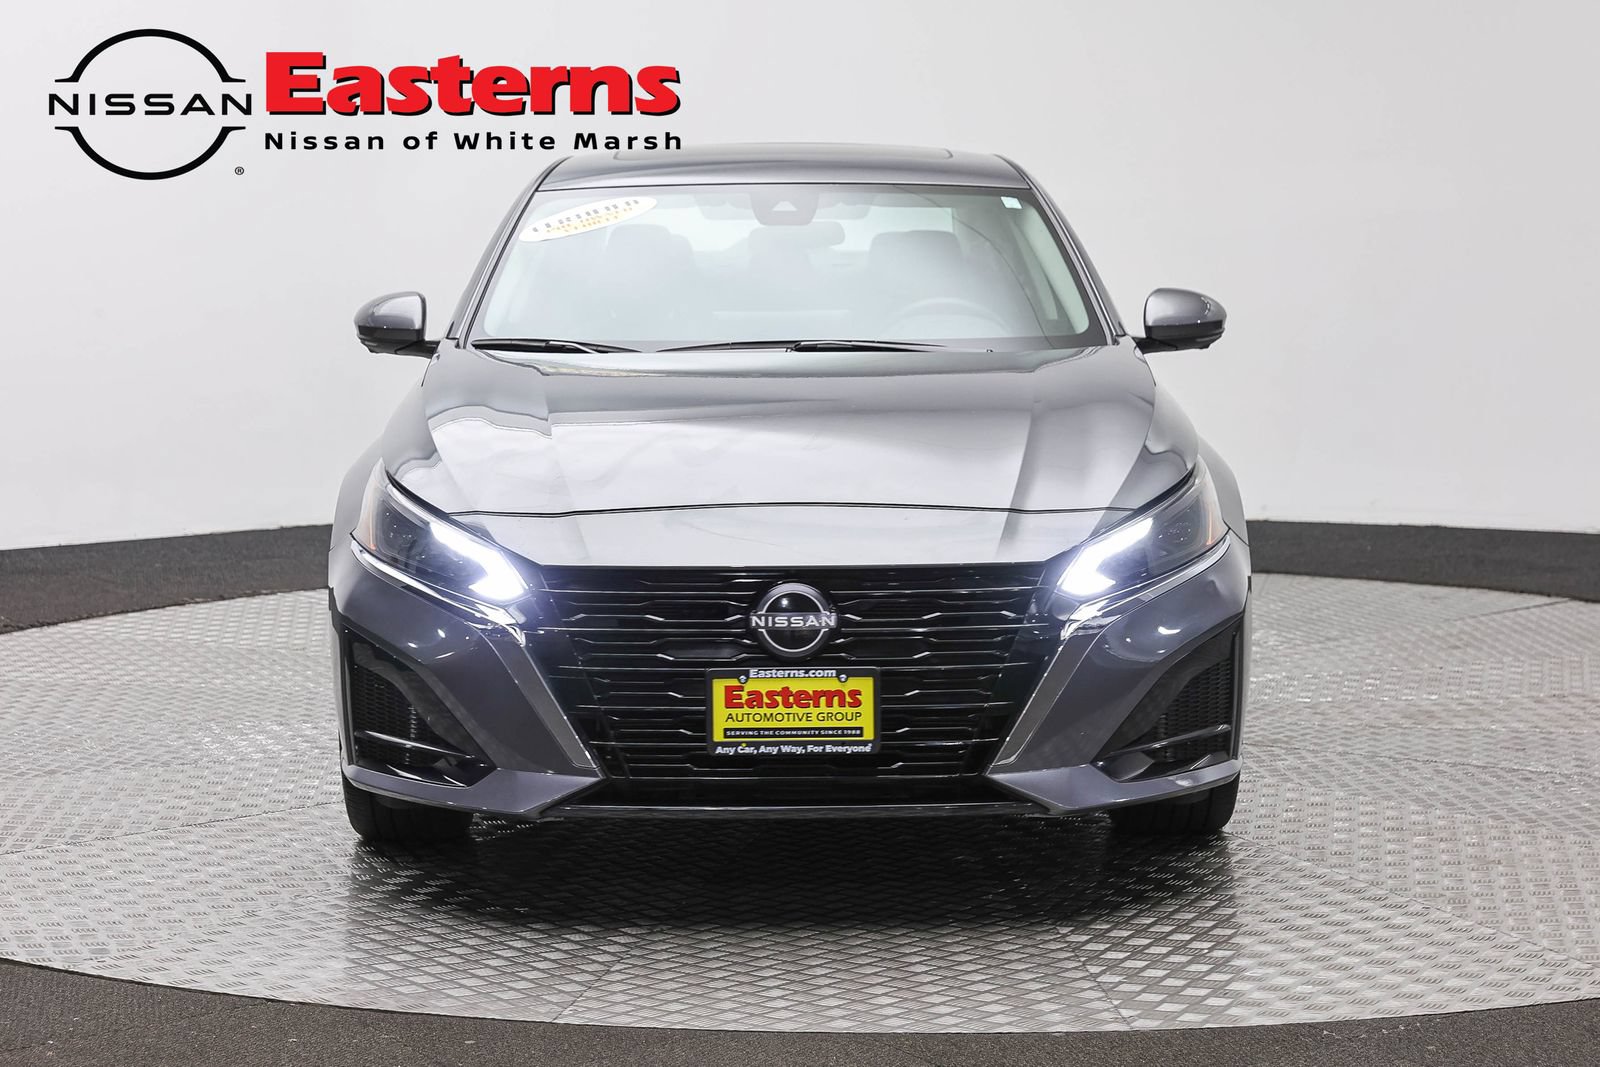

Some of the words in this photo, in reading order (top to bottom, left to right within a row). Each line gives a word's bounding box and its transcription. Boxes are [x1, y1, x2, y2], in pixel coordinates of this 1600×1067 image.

[751, 615, 835, 628] NISSAN
[749, 669, 837, 678] Easterns.com
[724, 685, 862, 709] Easterns
[725, 712, 813, 723] AUTOMOTIVE
[816, 711, 863, 722] GROUP
[715, 746, 736, 755] Any
[758, 745, 780, 755] Any
[780, 745, 806, 755] Way,
[807, 744, 824, 753] For
